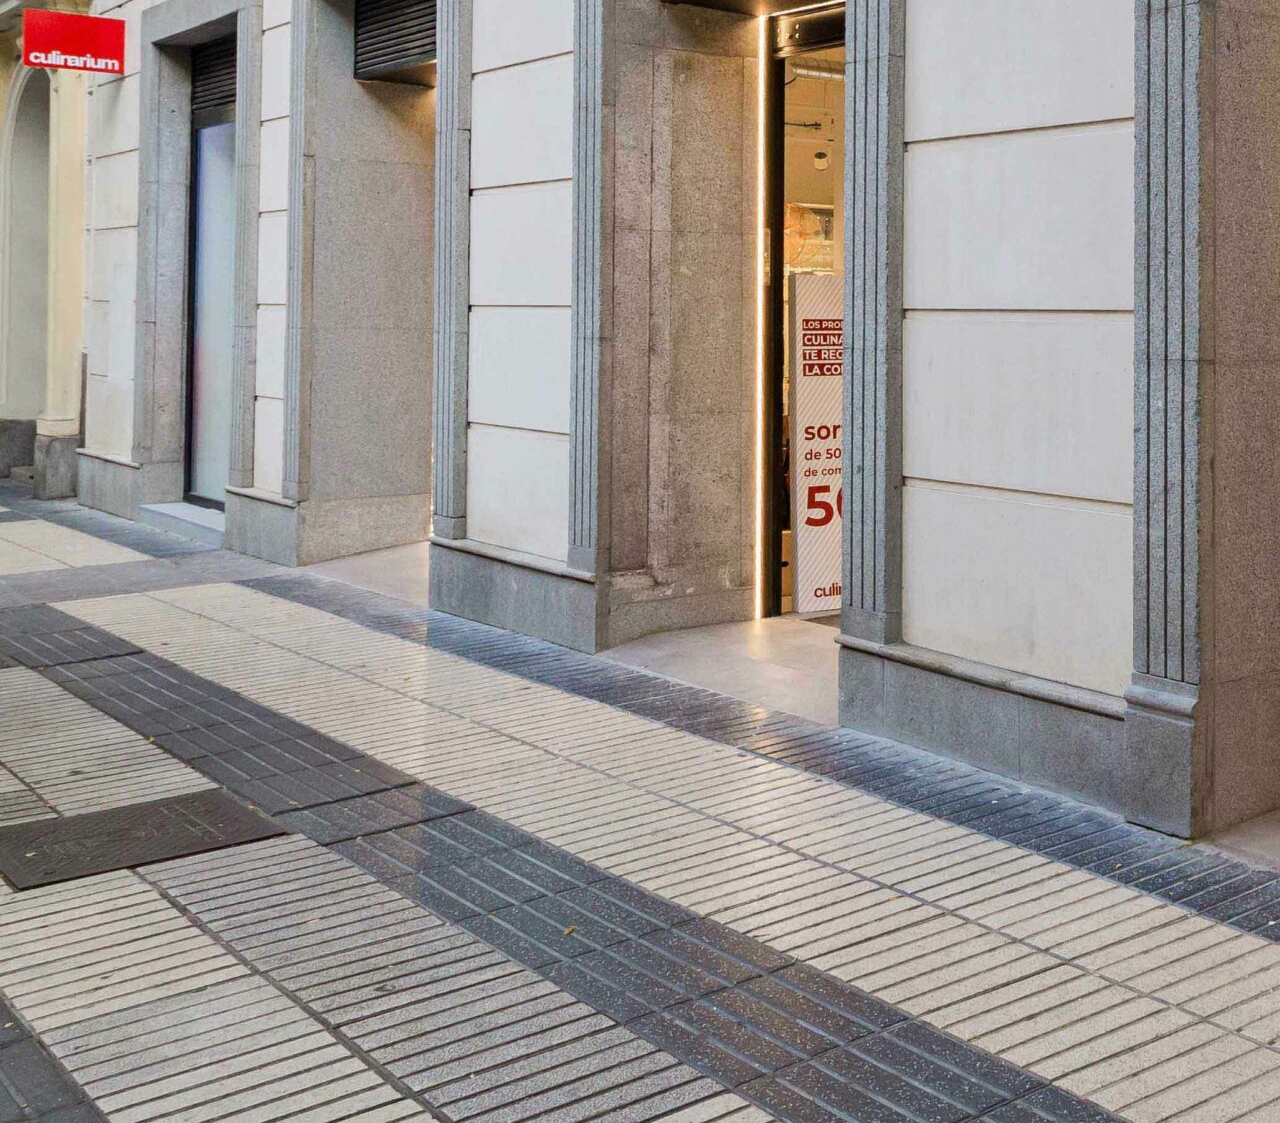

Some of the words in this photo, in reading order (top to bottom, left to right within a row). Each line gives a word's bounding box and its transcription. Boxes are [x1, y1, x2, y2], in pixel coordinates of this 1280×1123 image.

[28, 50, 119, 71] culinarium
[803, 321, 820, 329] LOS
[822, 321, 844, 329] PRO
[804, 350, 818, 360] TE
[805, 365, 820, 375] LA
[823, 364, 844, 375] CO
[805, 449, 822, 461] de
[825, 447, 842, 460] 50
[804, 467, 818, 477] de
[805, 485, 842, 527] 5
